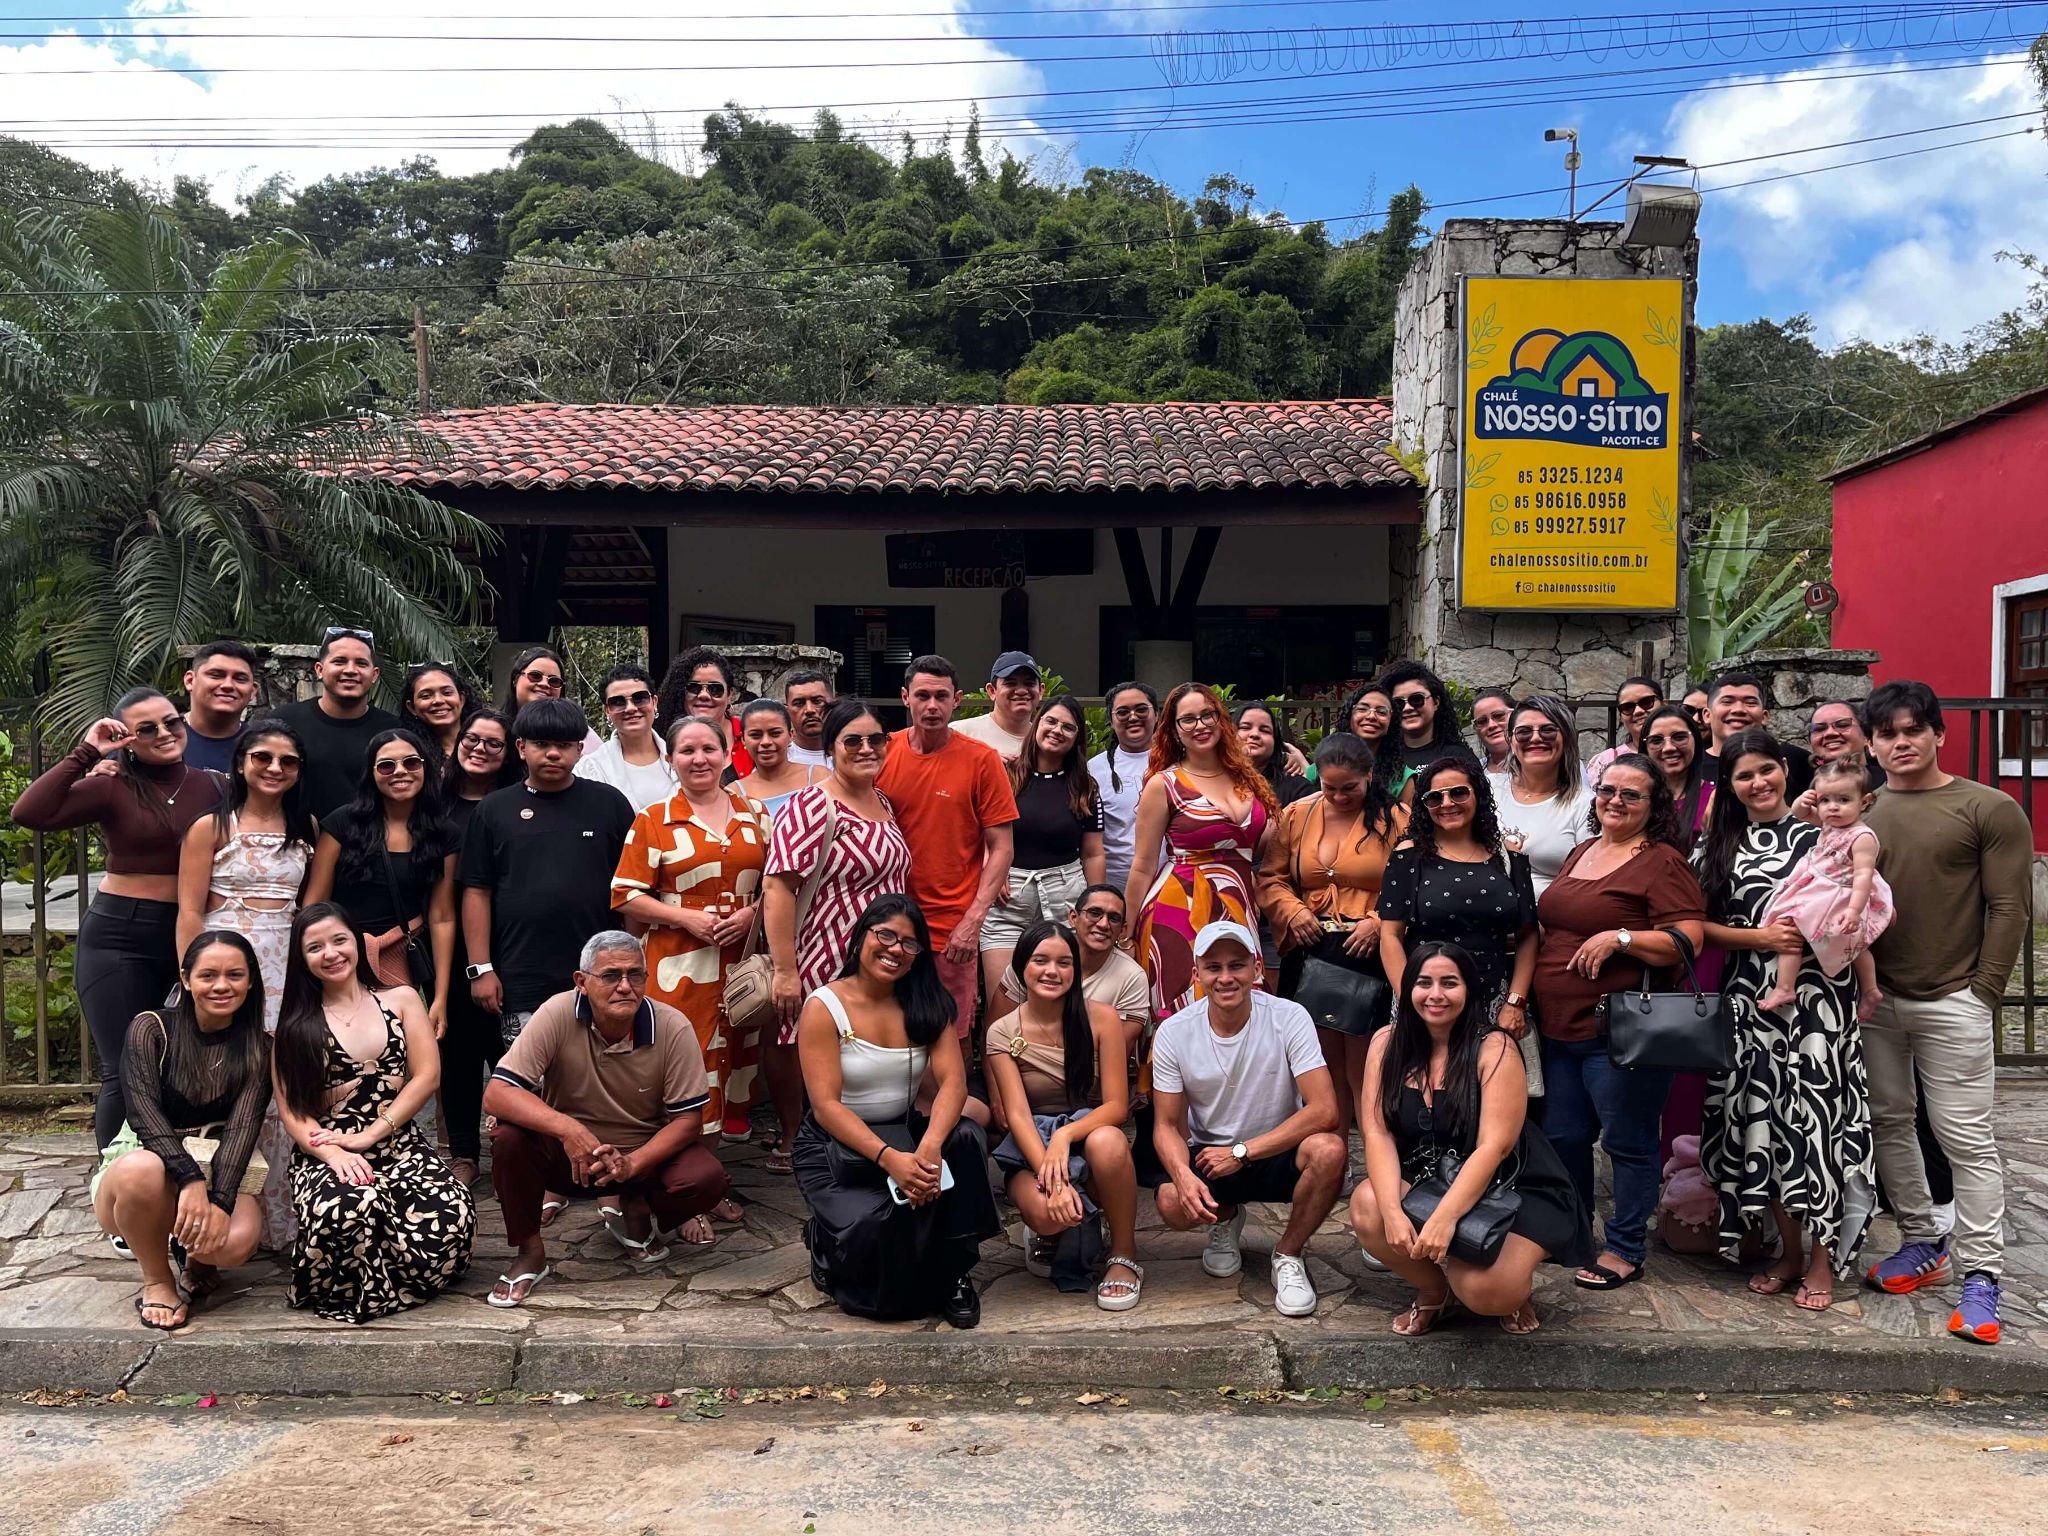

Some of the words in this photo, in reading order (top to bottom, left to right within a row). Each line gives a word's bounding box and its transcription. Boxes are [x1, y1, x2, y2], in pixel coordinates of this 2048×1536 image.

[1483, 390, 1518, 401] CHALÉ
[1601, 436, 1660, 446] PACOTI-CE
[1518, 470, 1533, 484] 85
[1539, 466, 1624, 484] 3325.1234
[1514, 495, 1529, 509] 85
[1535, 492, 1627, 509] 98616.0958
[1514, 520, 1529, 534] 85
[1535, 517, 1626, 534] 99927.5917
[1490, 552, 1649, 568] chalenossositio.com.br
[944, 561, 1025, 588] RECEPÇÃO
[1537, 582, 1616, 593] chalenossositio
